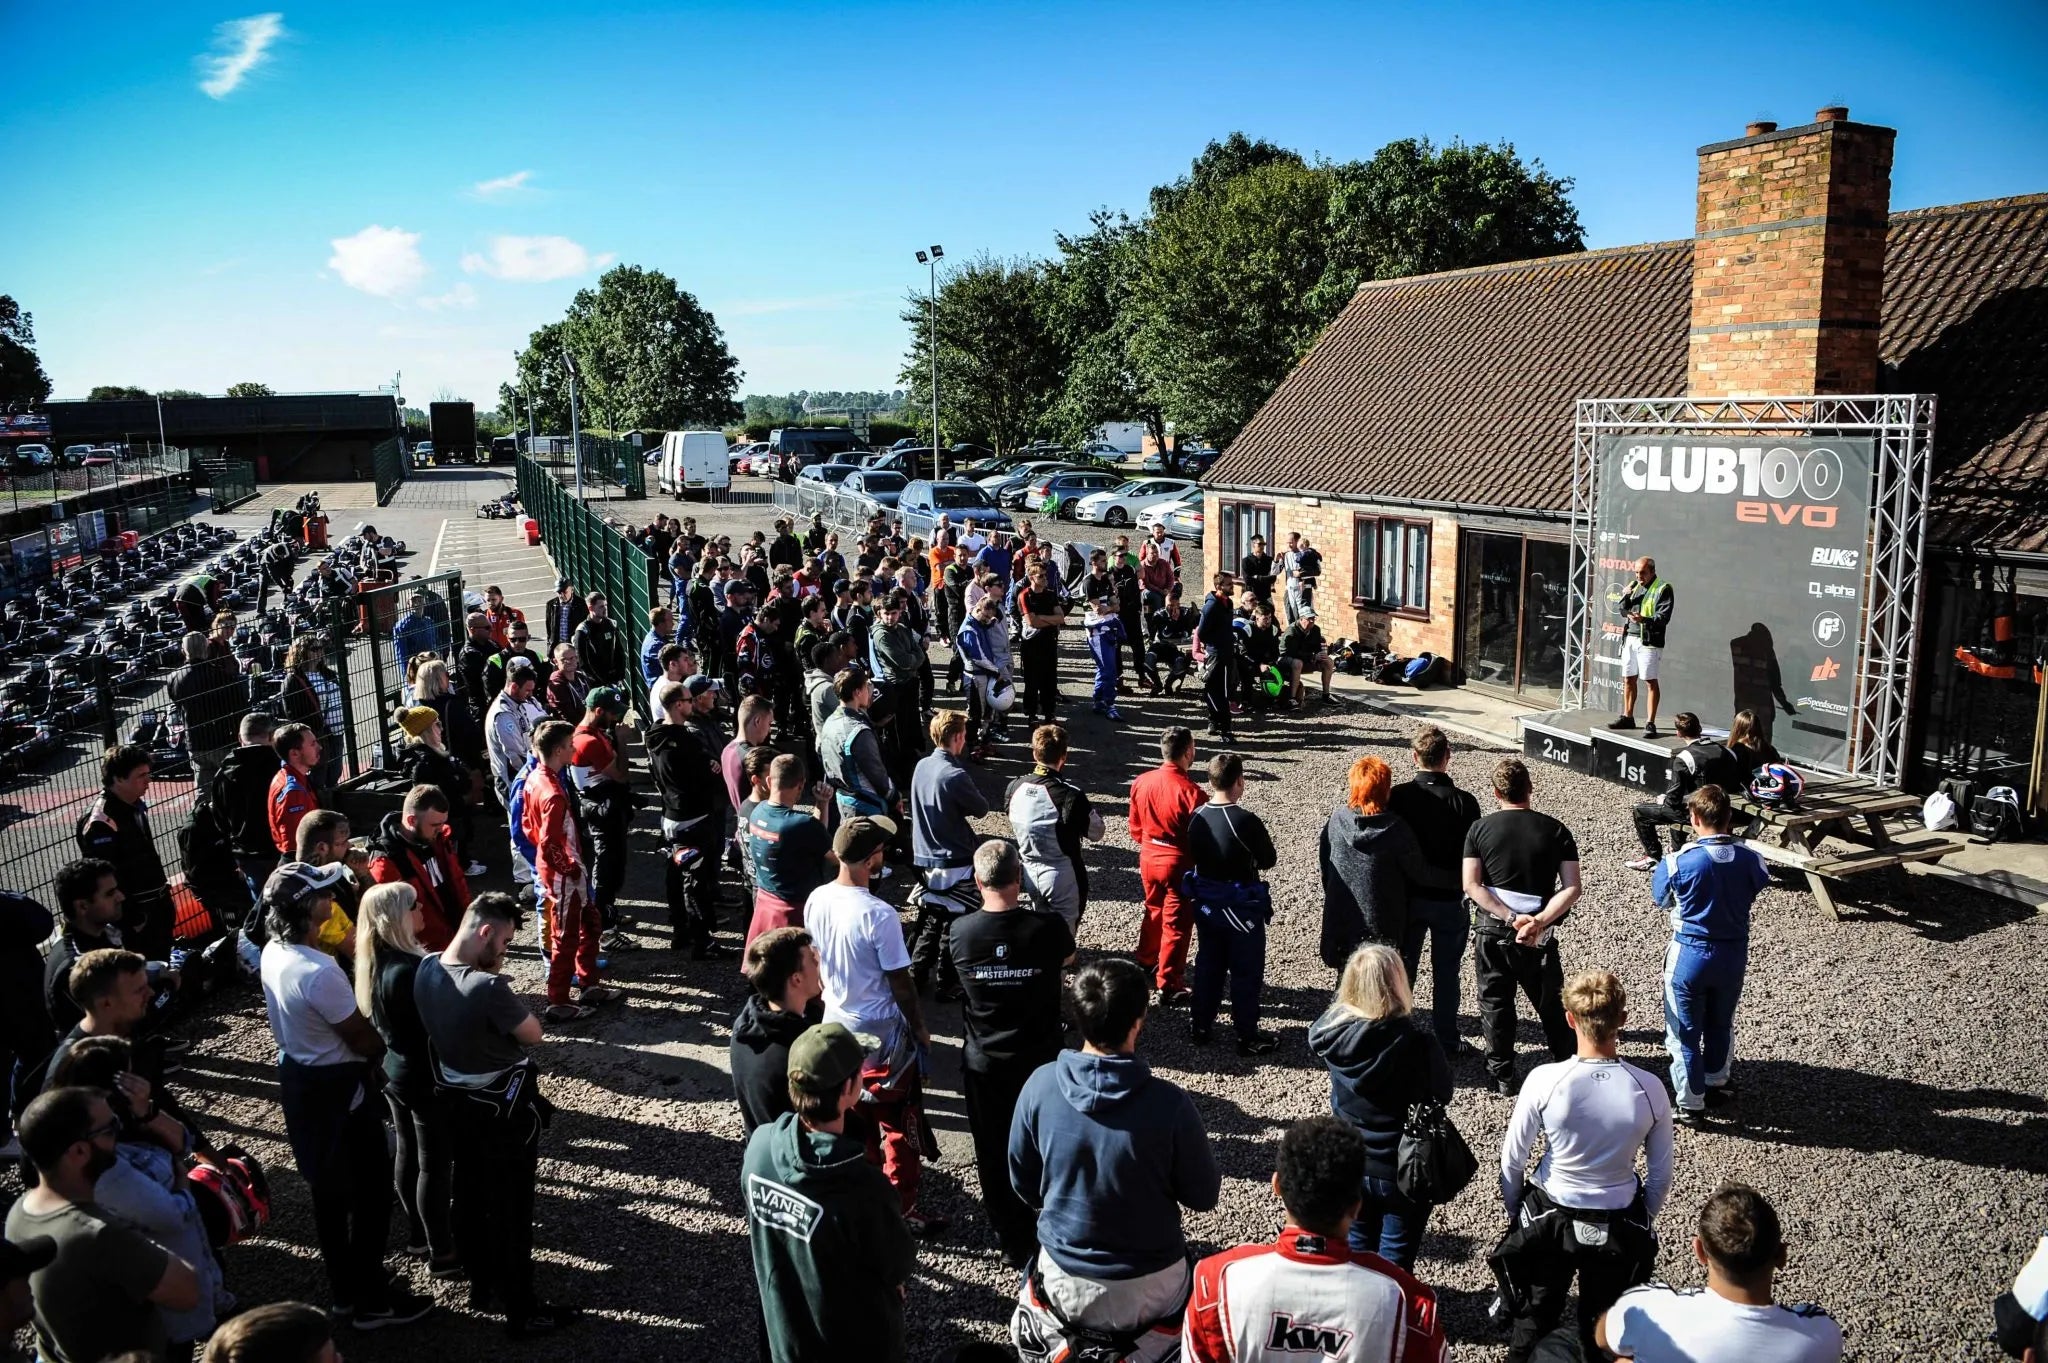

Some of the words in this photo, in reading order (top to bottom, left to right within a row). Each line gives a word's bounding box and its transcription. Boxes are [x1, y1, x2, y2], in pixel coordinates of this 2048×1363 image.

[1621, 445, 1843, 500] CLUB100
[1599, 557, 1635, 571] ROTAX
[1811, 547, 1859, 567] BUKC
[1824, 584, 1856, 597] alpha
[1592, 676, 1625, 690] BALLINGE
[1807, 697, 1849, 712] Speedscreen
[1542, 738, 1570, 764] 2nd
[1616, 752, 1647, 785] 1st
[975, 968, 1033, 979] MASTERPIECE
[760, 1186, 806, 1219] VANS
